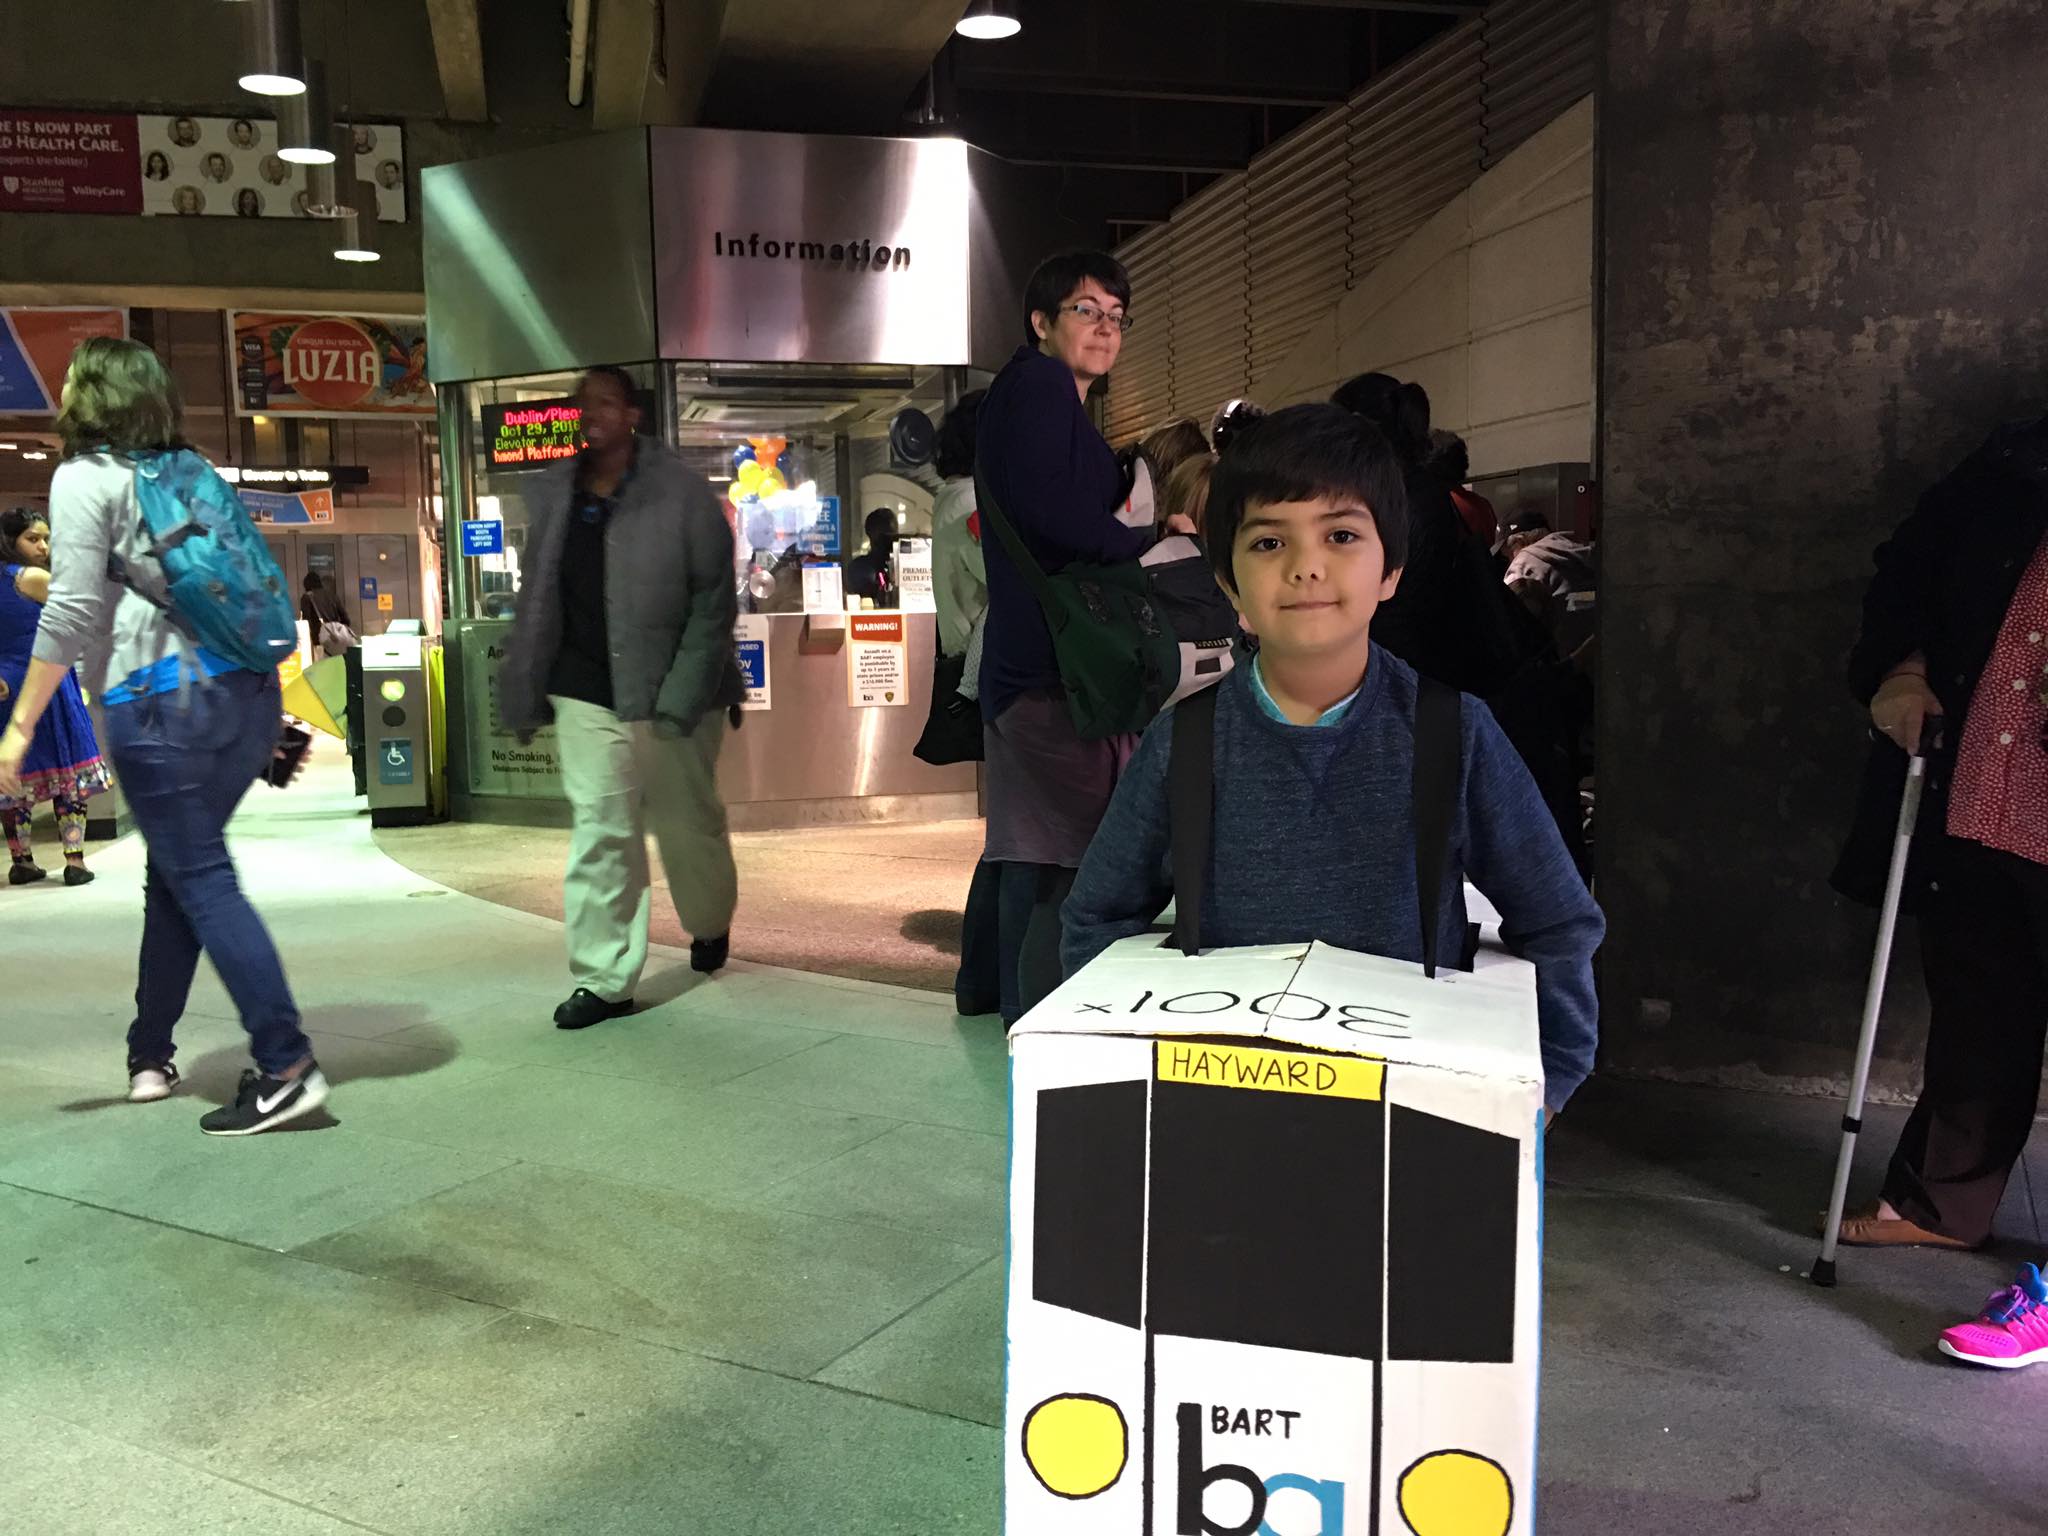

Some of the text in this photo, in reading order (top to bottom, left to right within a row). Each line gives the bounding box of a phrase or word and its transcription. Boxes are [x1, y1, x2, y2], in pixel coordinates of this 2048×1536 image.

[16, 121, 31, 132] IS
[34, 122, 70, 134] NOW
[74, 122, 112, 135] PART
[16, 135, 75, 150] HEALTH
[79, 137, 124, 152] CARE.
[21, 177, 64, 186] Stanford
[72, 186, 126, 197] ValleyCare
[715, 231, 911, 264] Information
[282, 349, 381, 386] LUZIA
[500, 424, 521, 437] Oct
[495, 436, 536, 450] Elevator
[542, 435, 557, 445] out
[855, 622, 898, 631] WARNING!
[492, 750, 505, 760] No
[508, 750, 554, 765] Smoking,
[521, 765, 545, 774] Subject
[1172, 1046, 1337, 1091] HAYWARD
[1211, 1404, 1301, 1439] BART
